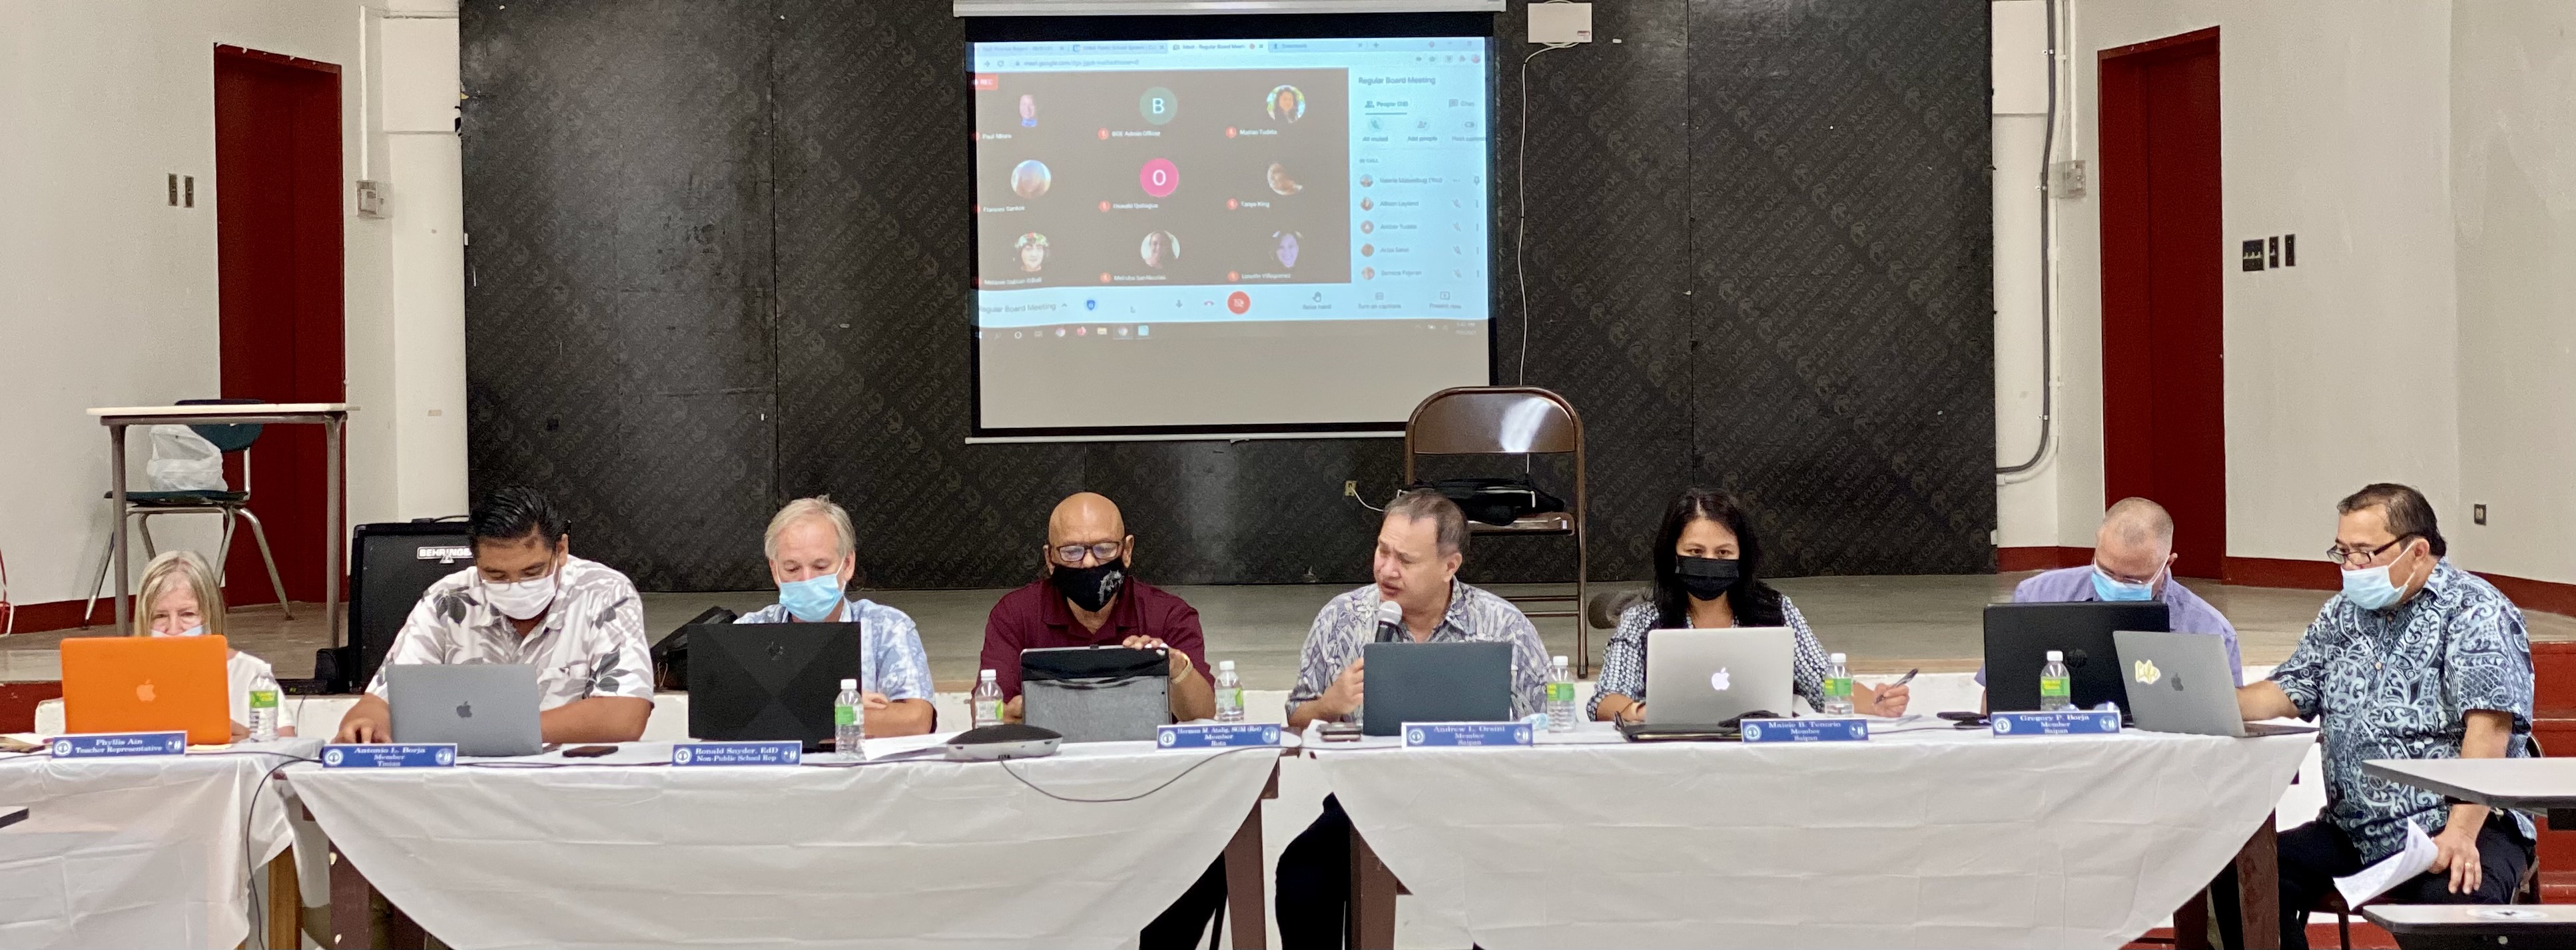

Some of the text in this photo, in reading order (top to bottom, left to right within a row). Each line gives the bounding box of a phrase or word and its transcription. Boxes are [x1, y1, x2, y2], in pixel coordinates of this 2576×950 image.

[1359, 77, 1384, 86] Regular
[1407, 77, 1436, 85] Meeting
[1152, 98, 1165, 114] B
[1153, 169, 1167, 186] O
[419, 547, 473, 557] BEHRINGE
